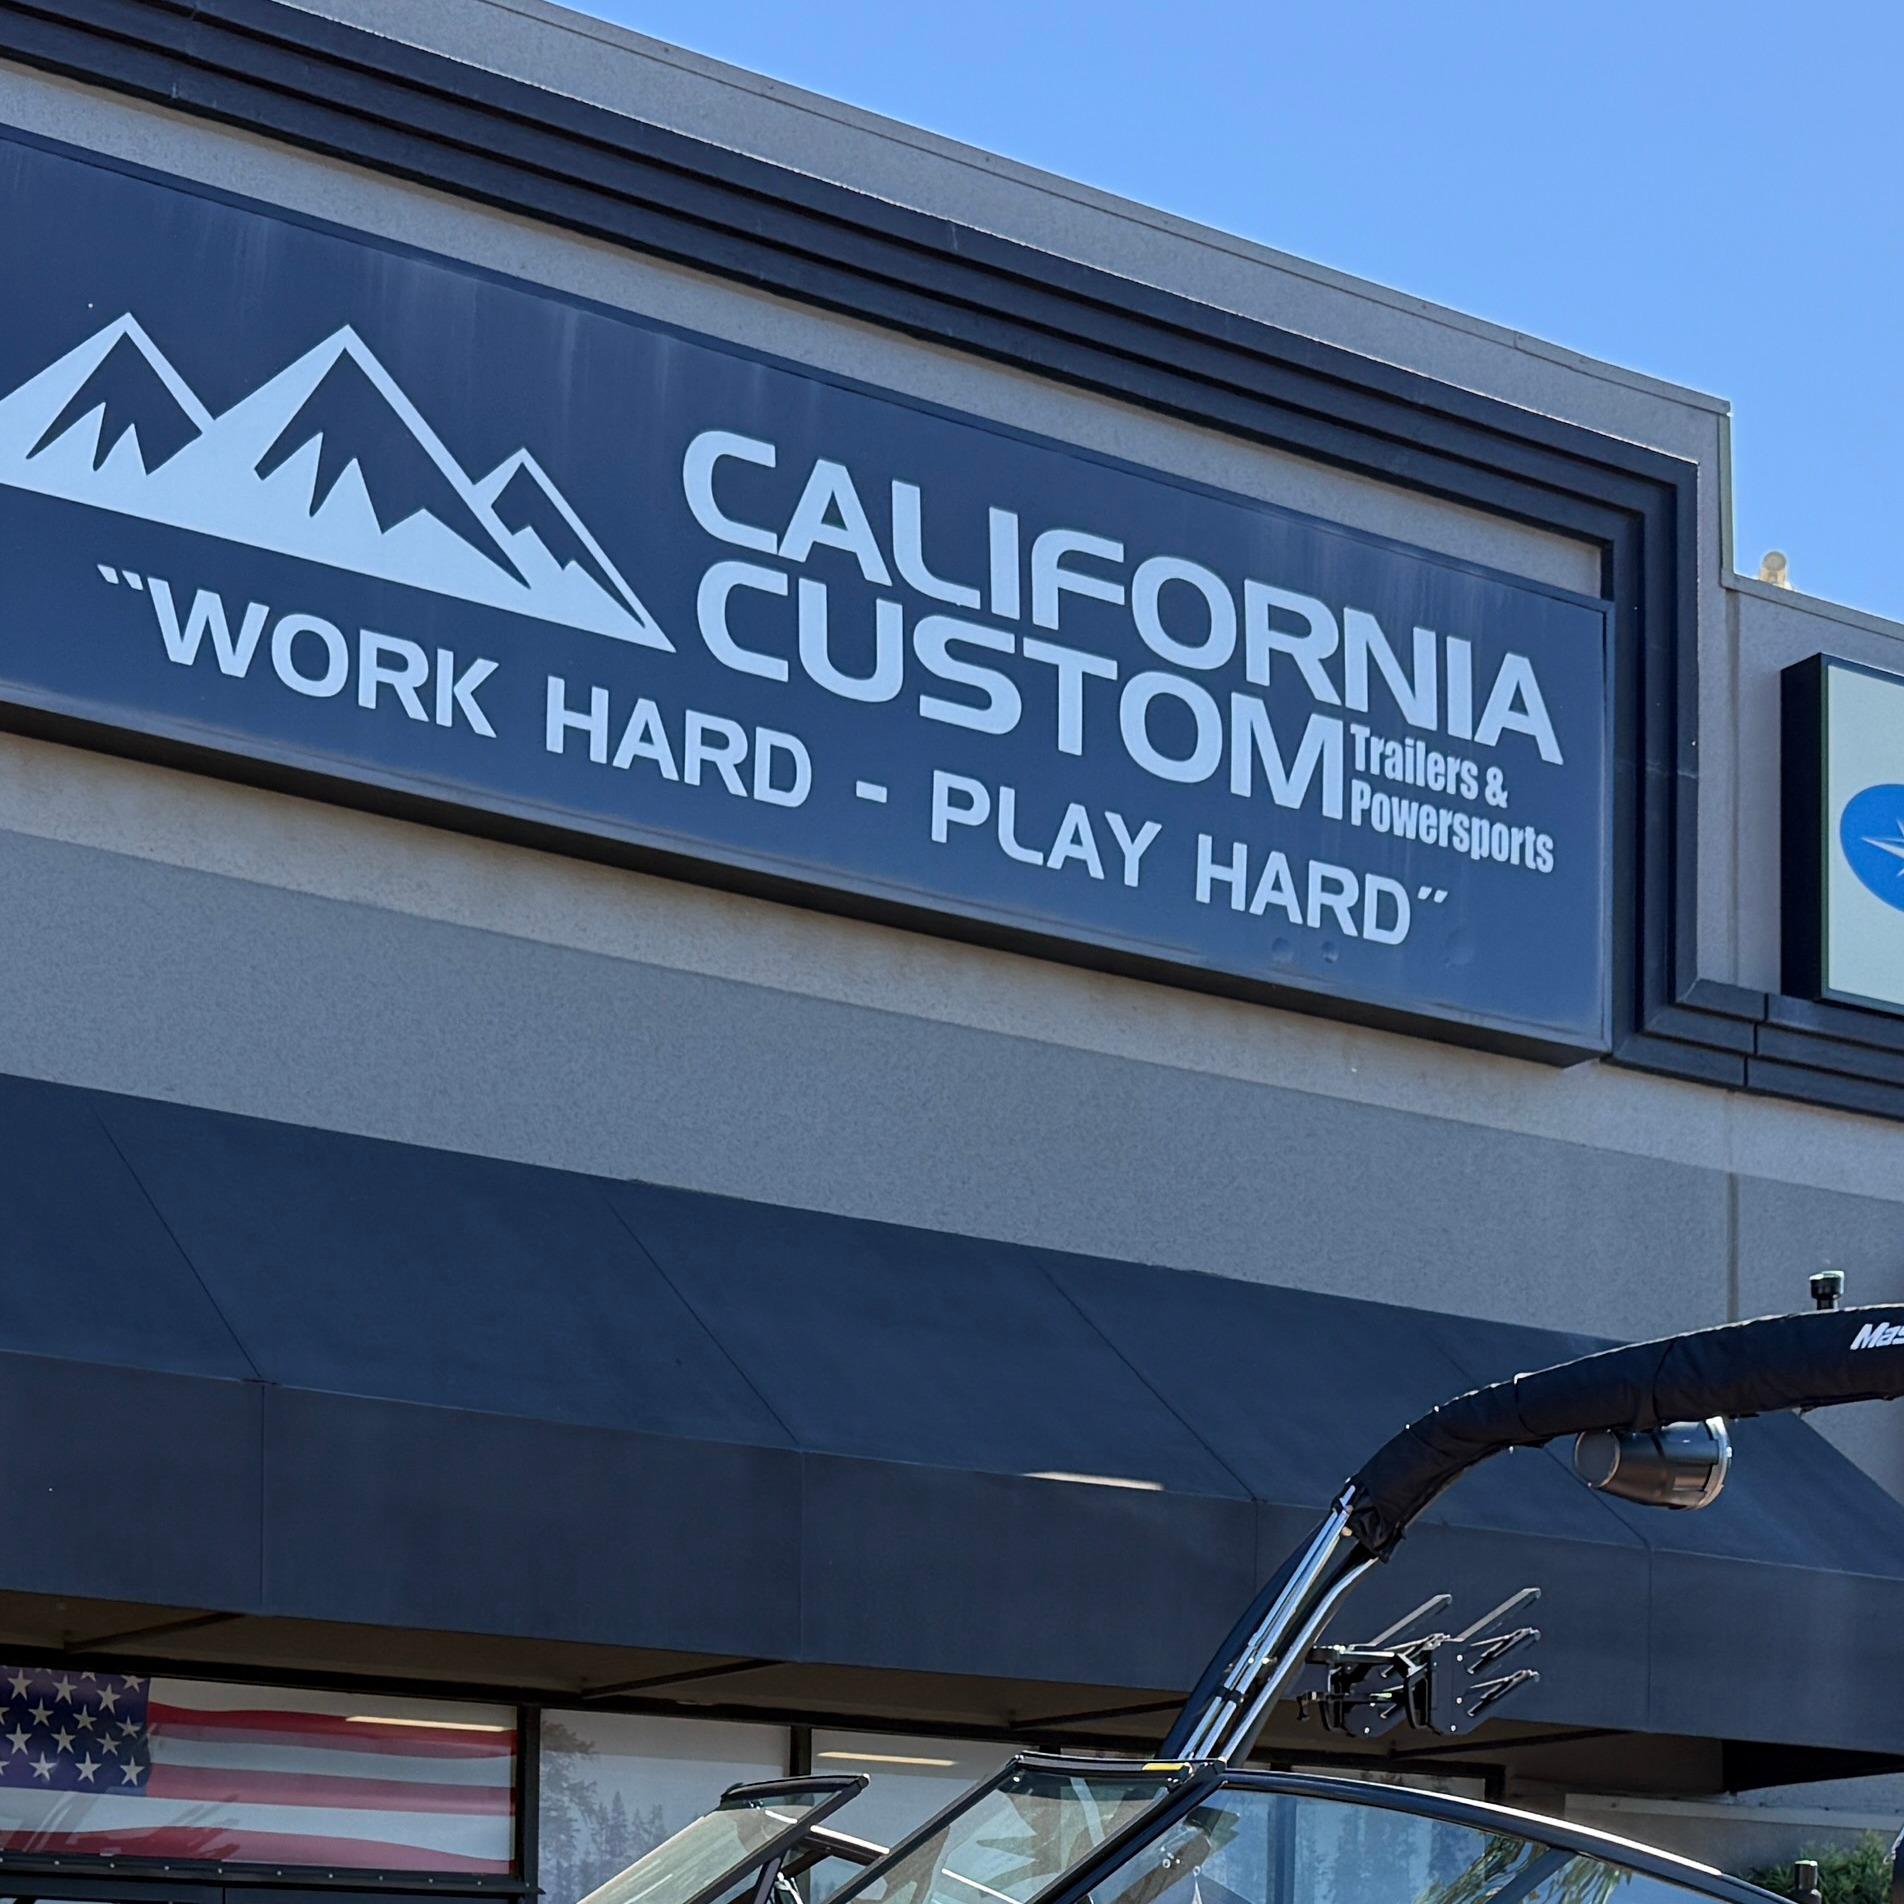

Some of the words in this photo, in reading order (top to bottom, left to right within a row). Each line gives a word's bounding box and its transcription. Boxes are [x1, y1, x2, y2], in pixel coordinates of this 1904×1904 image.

[682, 429, 1564, 766] CALIFORNIA
[696, 559, 1344, 820] CUSTOM
[546, 676, 812, 808] HARD
[930, 769, 1162, 888] PLAY
[1350, 722, 1479, 800] Trailers
[1484, 766, 1508, 809] &
[1350, 778, 1554, 873] Powersports
